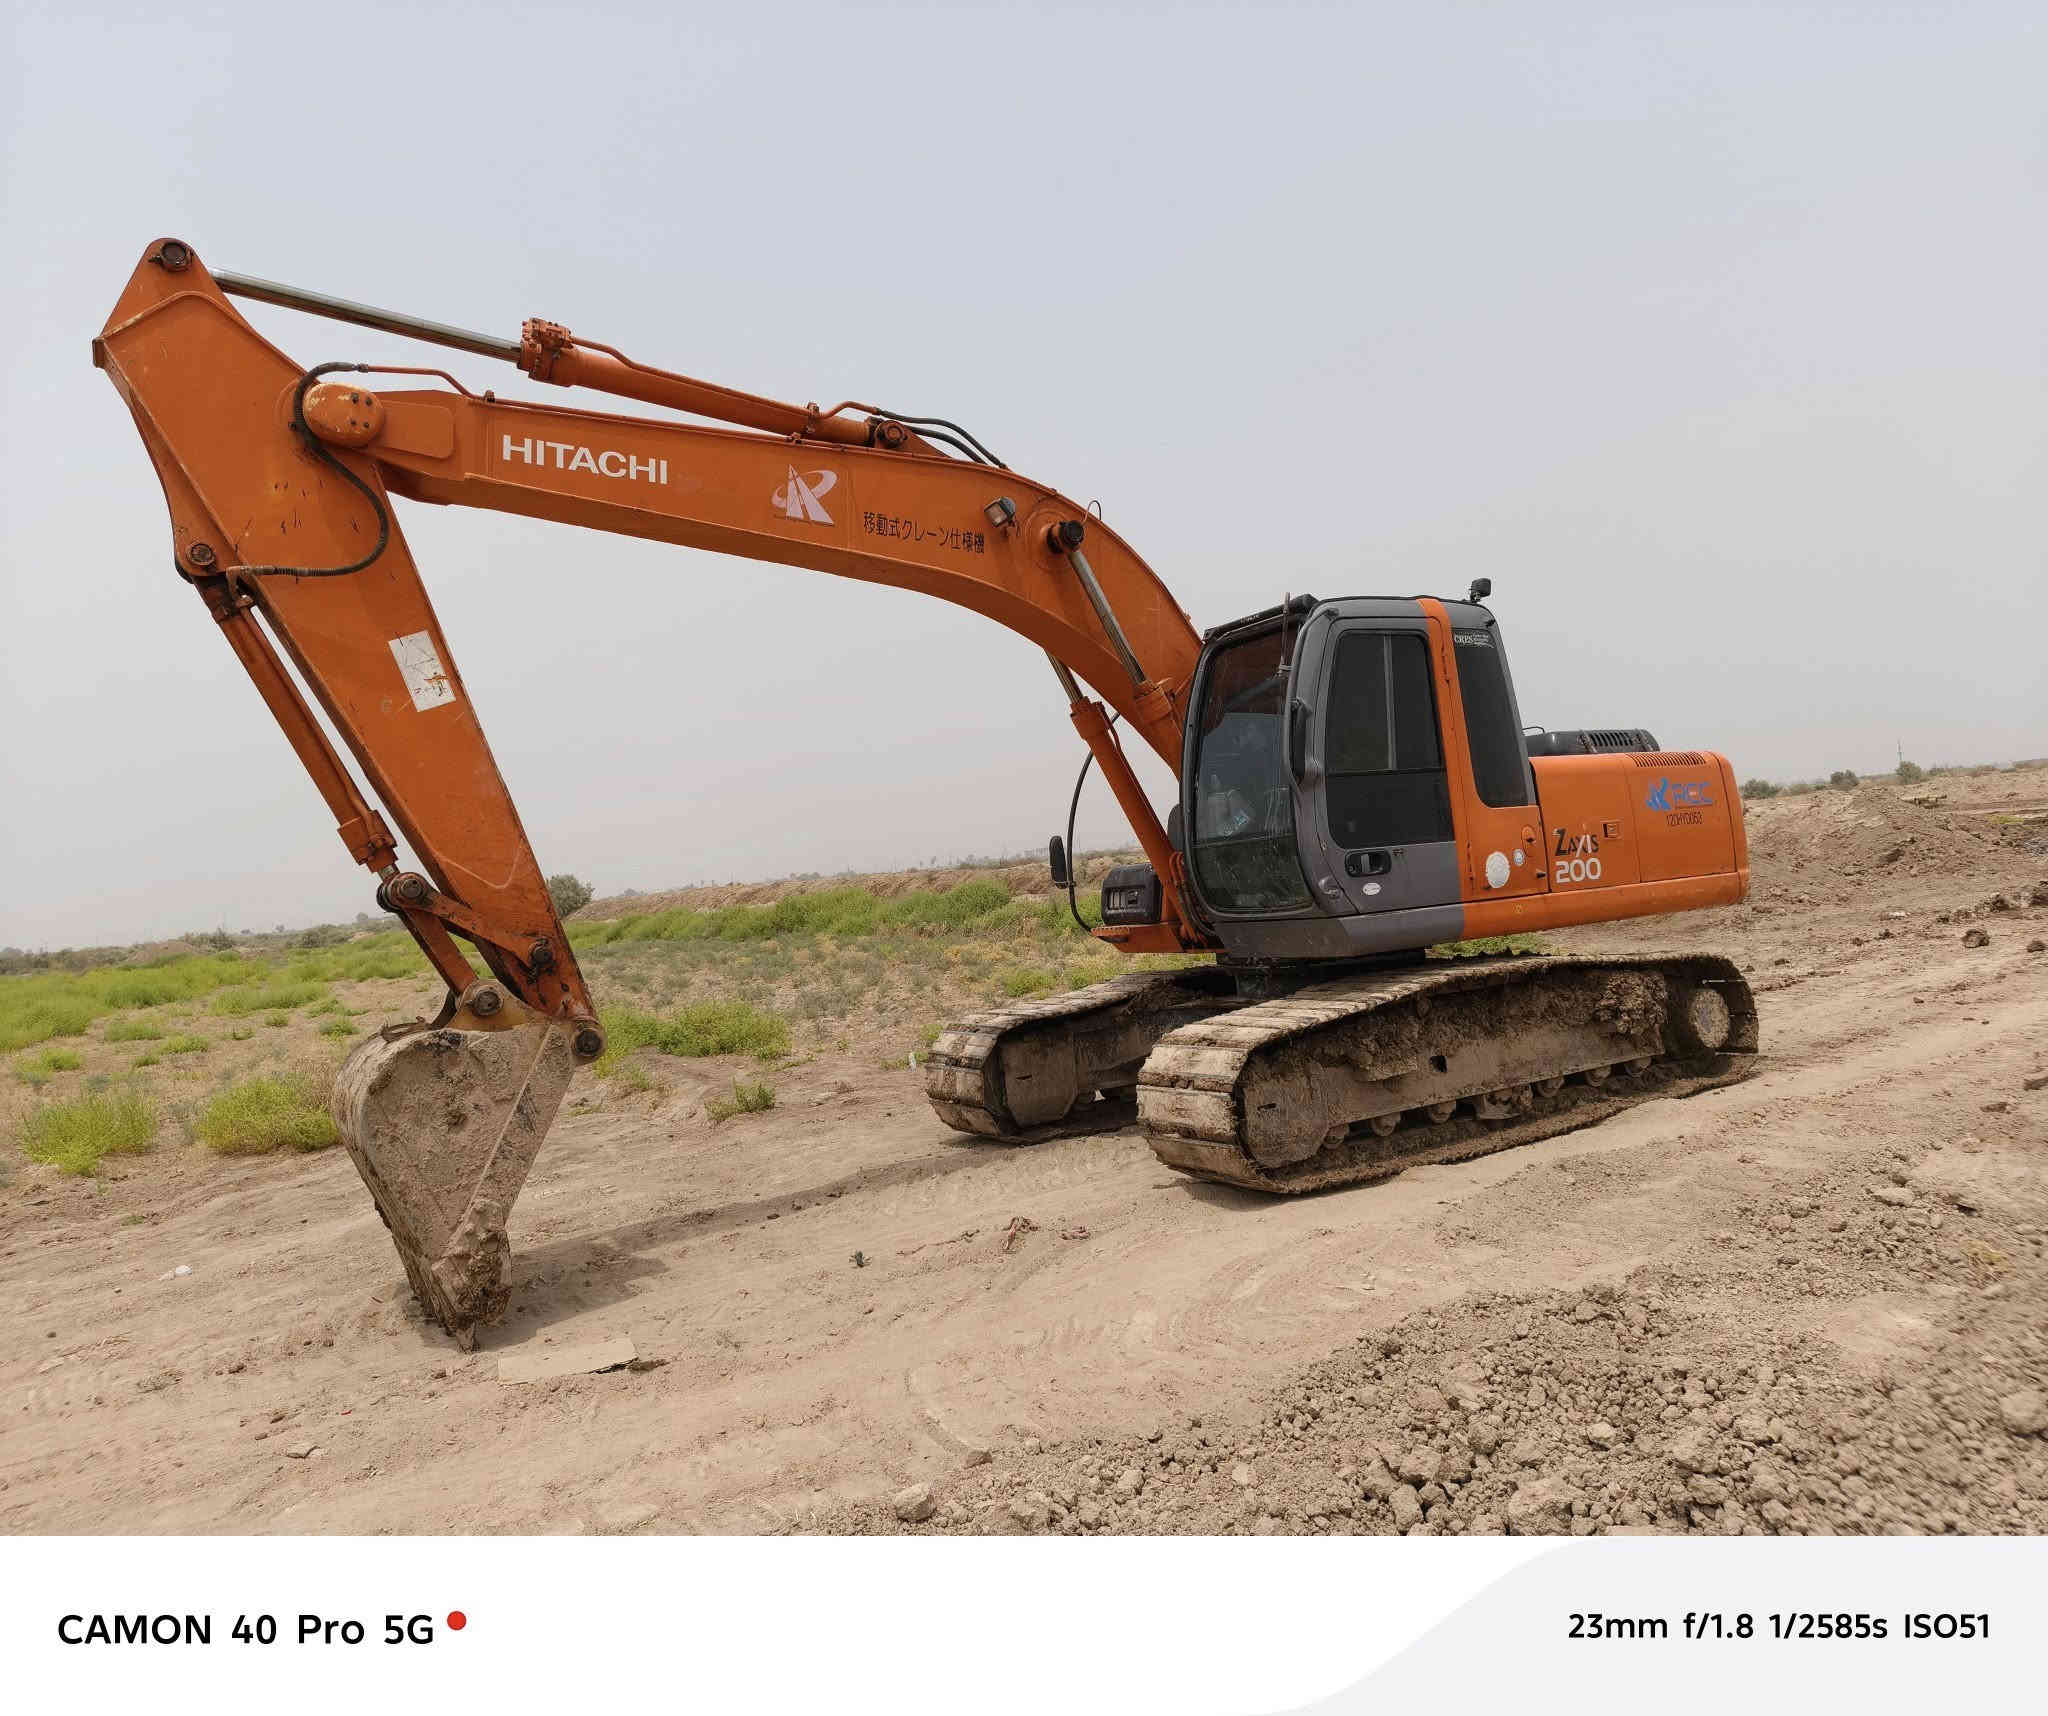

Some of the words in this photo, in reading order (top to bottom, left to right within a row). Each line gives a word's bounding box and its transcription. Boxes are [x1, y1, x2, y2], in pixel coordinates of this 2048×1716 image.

[502, 434, 668, 485] HITACHI
[863, 511, 985, 554] 移動式クレーン仕様機
[1555, 858, 1602, 884] 200
